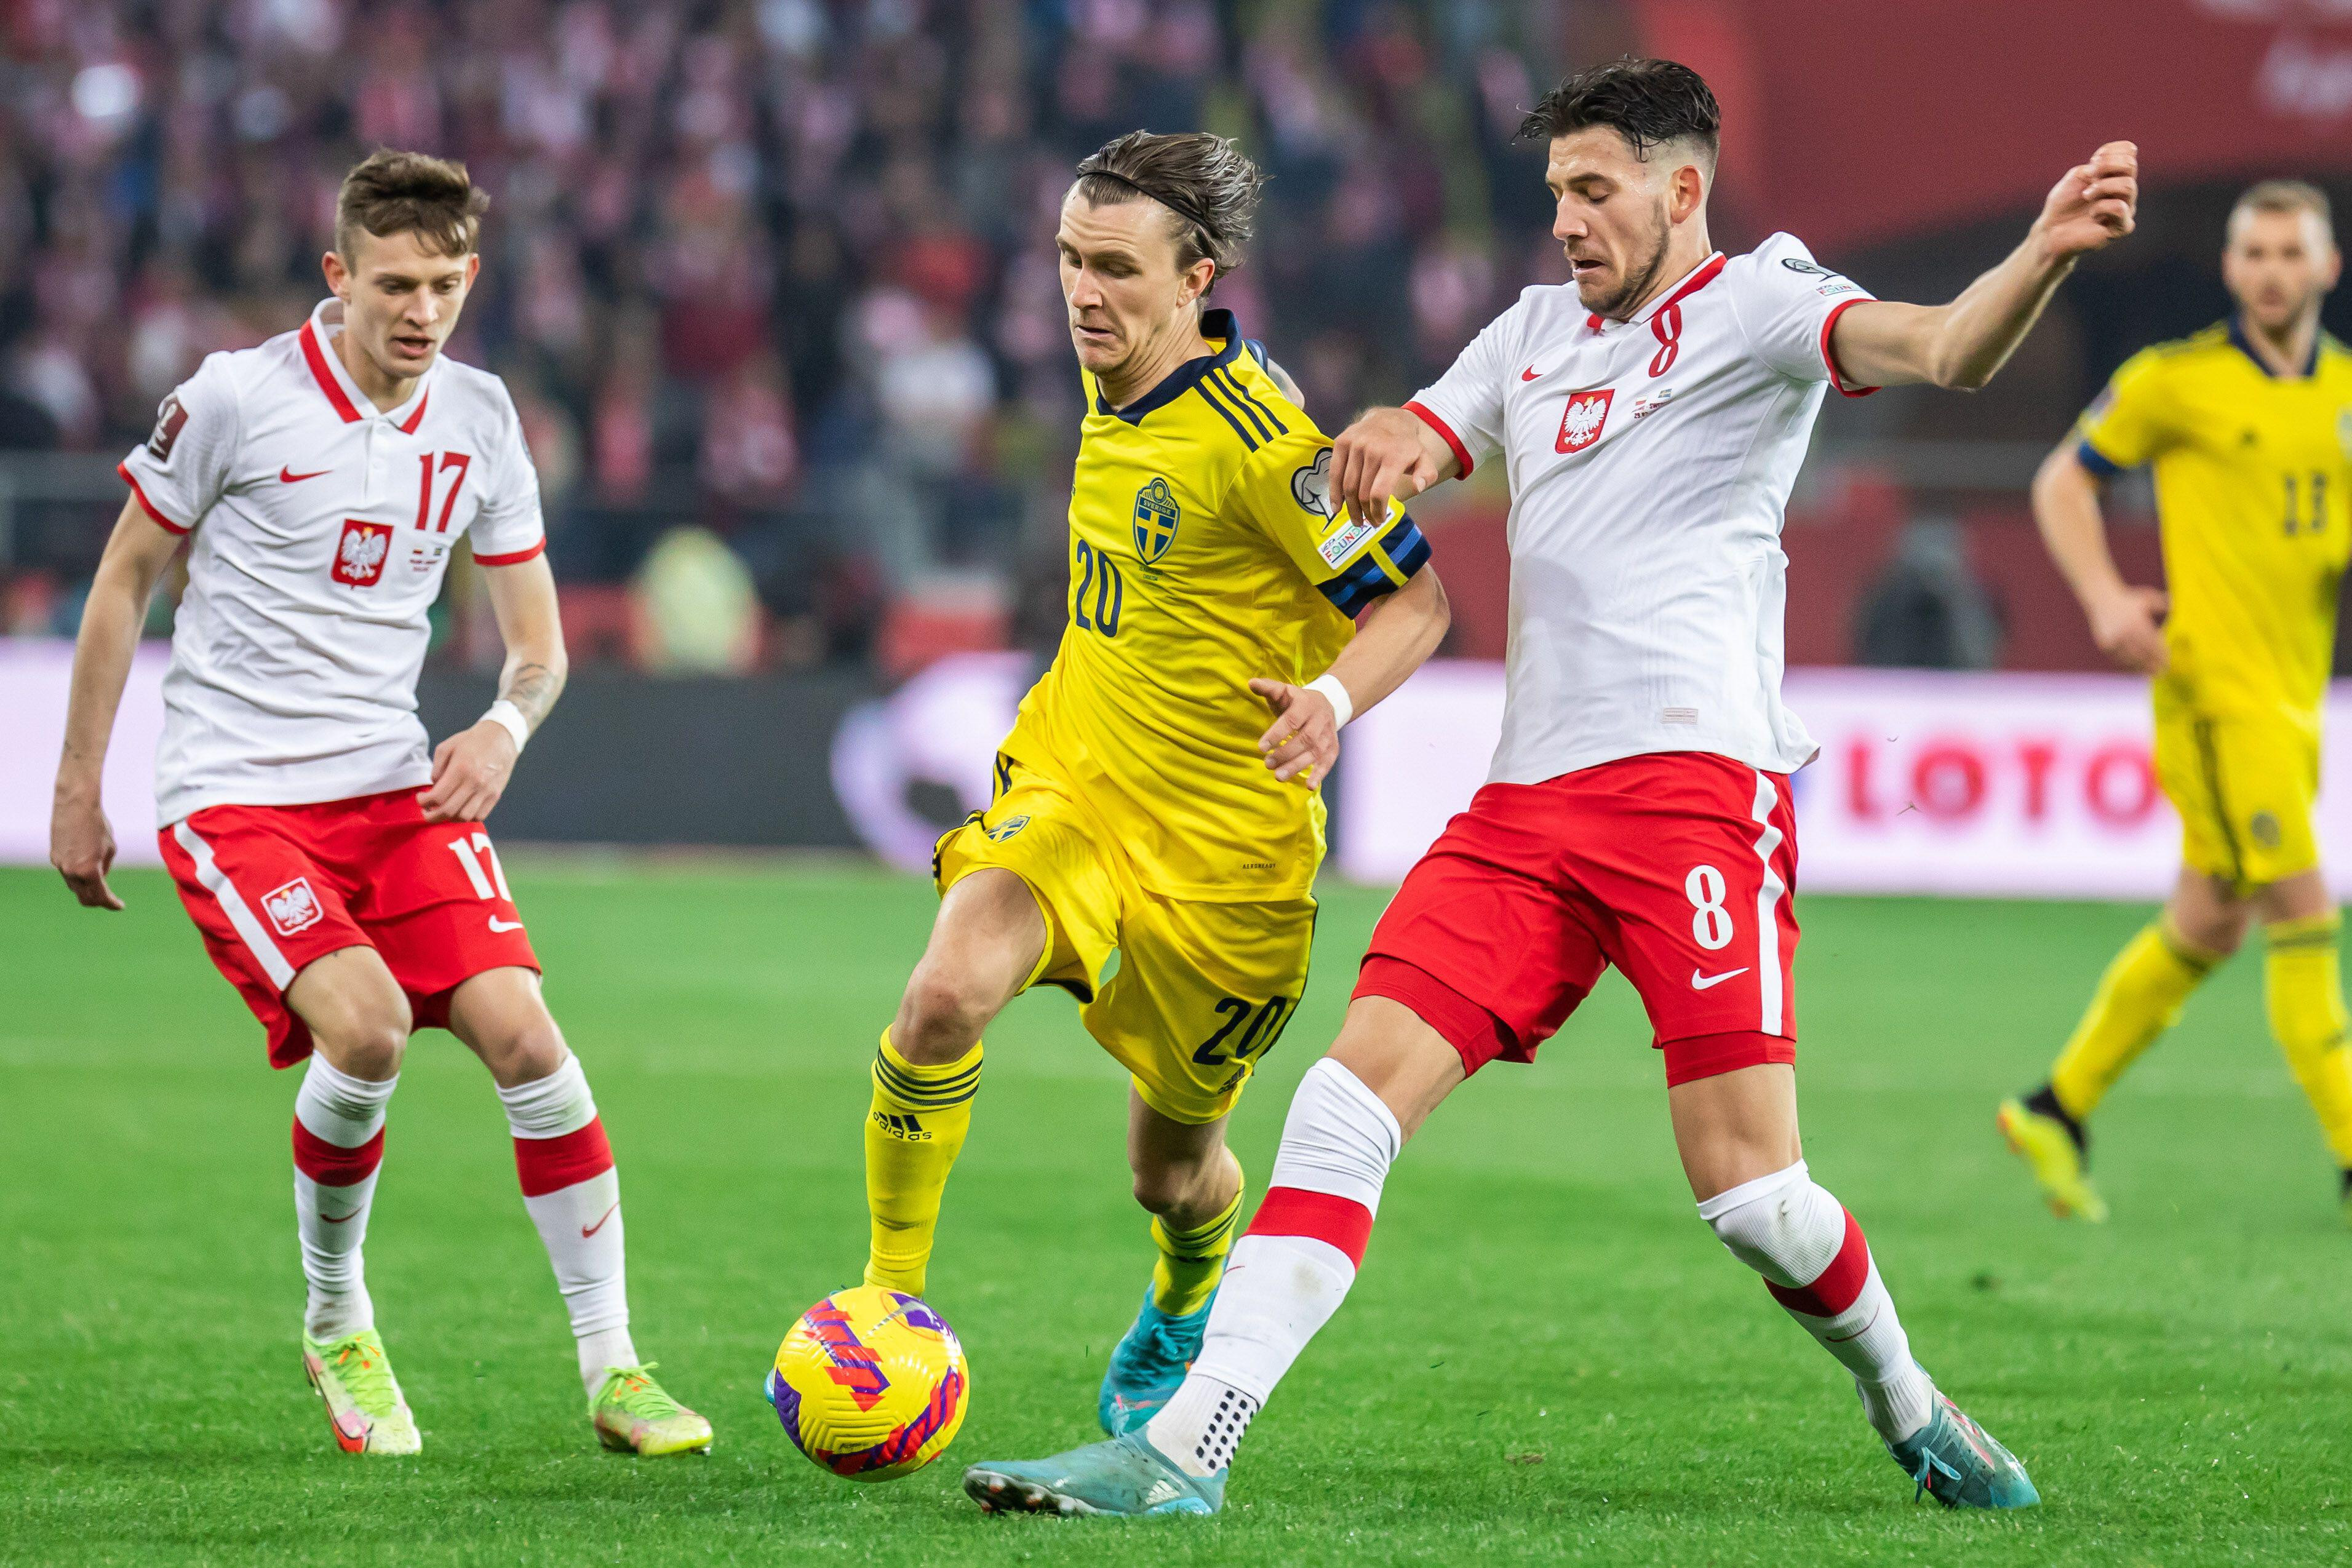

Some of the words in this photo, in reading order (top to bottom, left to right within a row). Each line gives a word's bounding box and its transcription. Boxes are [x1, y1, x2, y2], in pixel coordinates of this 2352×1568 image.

[1649, 304, 1682, 378] 8
[415, 451, 472, 533] 17
[1143, 499, 1171, 515] SVERIGE
[1076, 539, 1123, 638] 20
[447, 832, 512, 902] 17
[1685, 864, 1734, 950] 8
[1192, 995, 1287, 1065] 20
[873, 1111, 932, 1141] adidas
